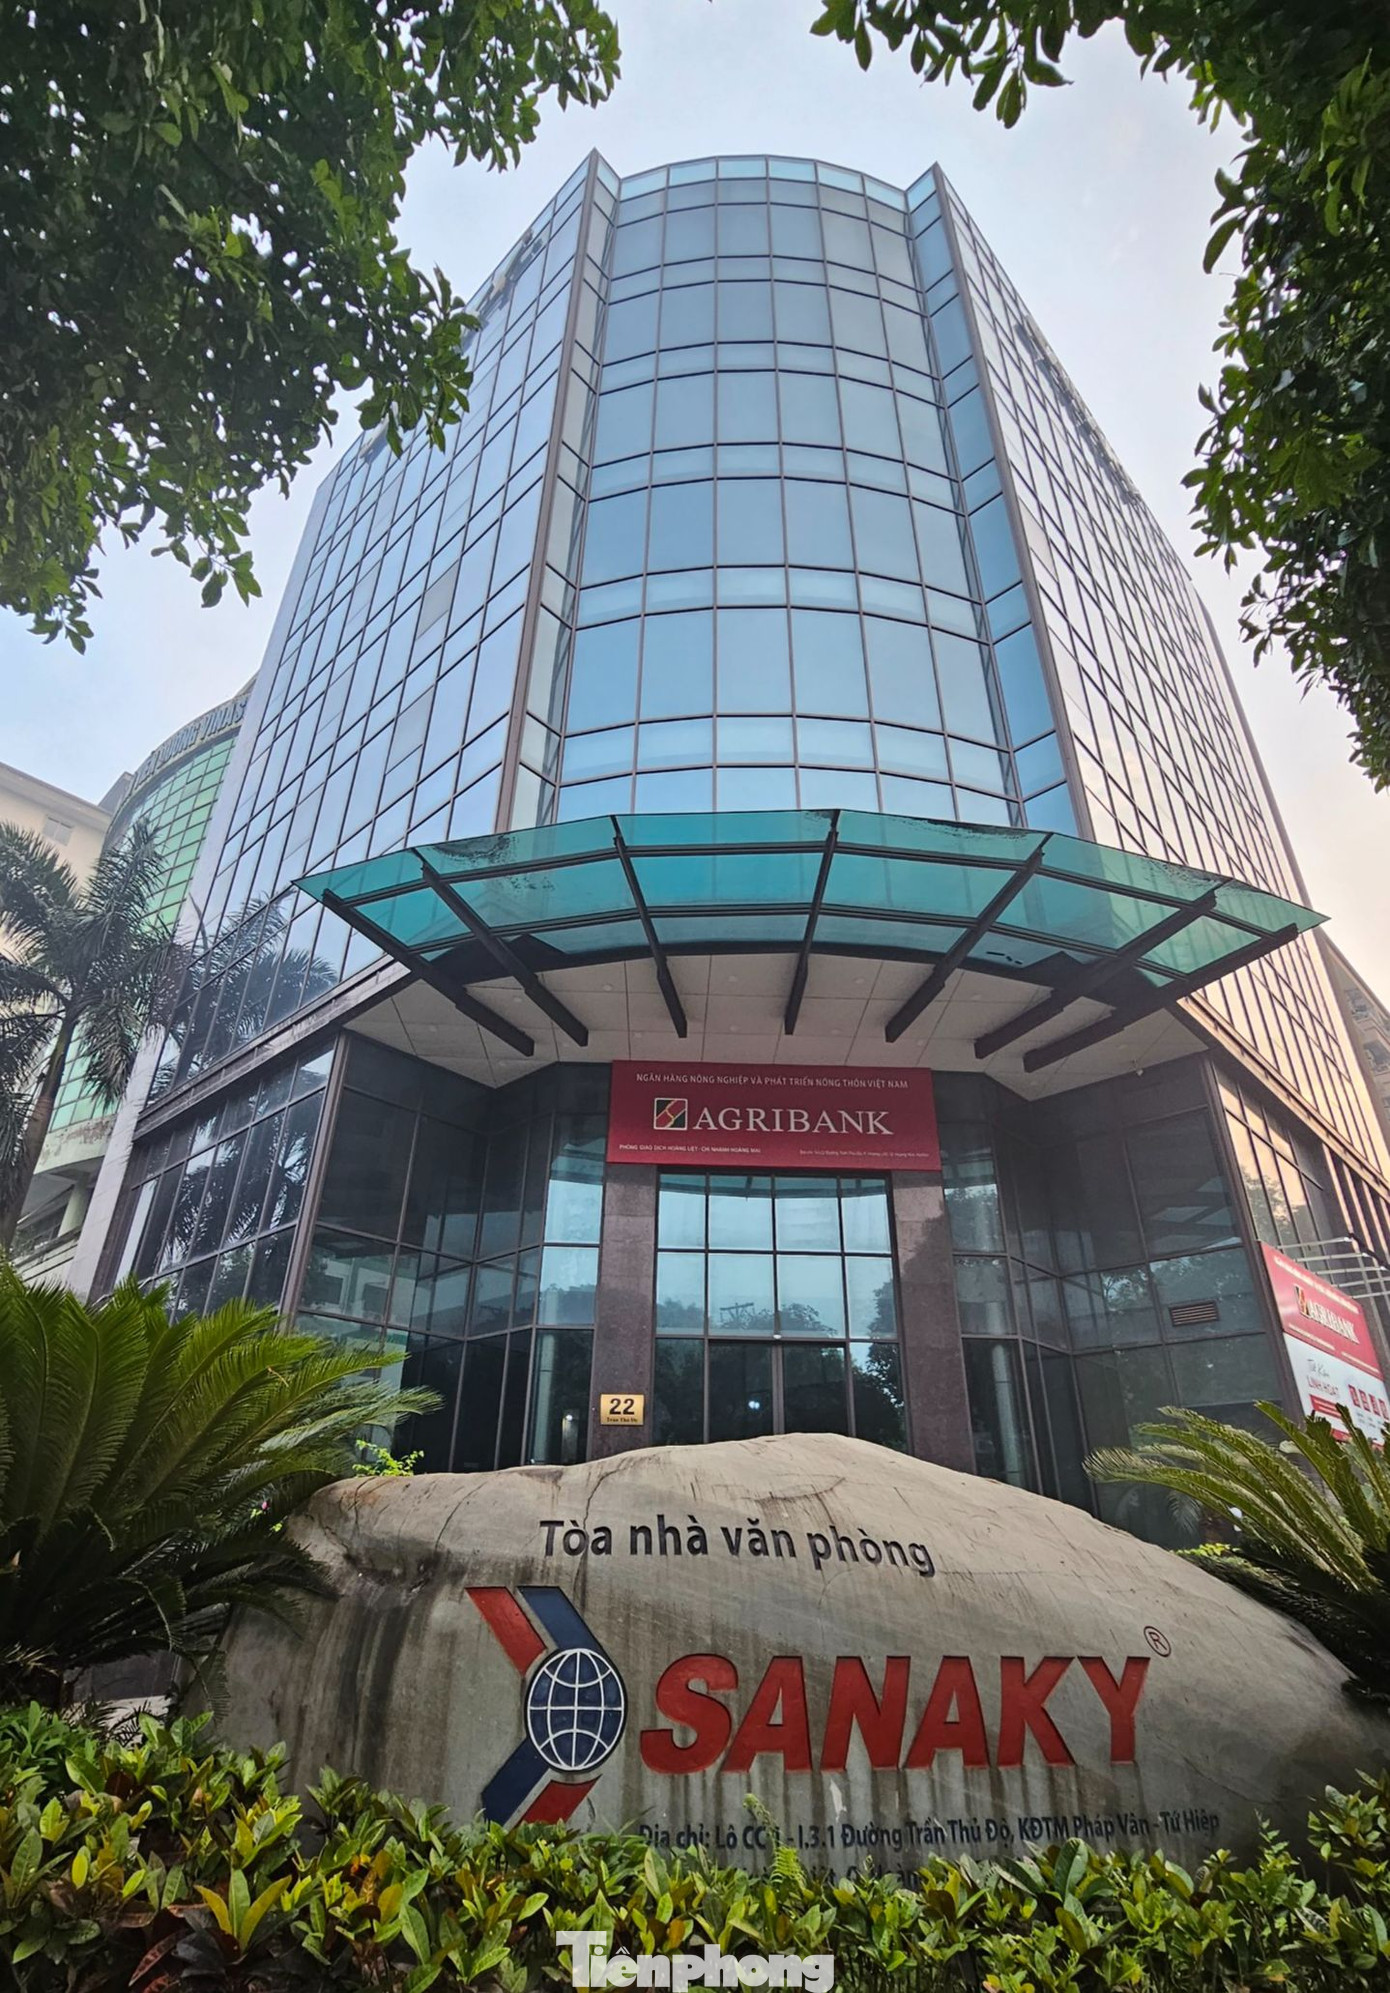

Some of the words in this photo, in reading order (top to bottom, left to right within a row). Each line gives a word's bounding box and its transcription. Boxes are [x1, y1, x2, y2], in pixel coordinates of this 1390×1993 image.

[636, 1073, 661, 1082] NGÂN
[663, 1073, 688, 1083] HÀNG
[690, 1074, 715, 1084] NÔNG
[717, 1075, 748, 1085] NGHIỆP
[750, 1075, 763, 1085] VÀ
[764, 1076, 787, 1085] PHÁT
[789, 1076, 814, 1087] TRIỂN
[816, 1077, 841, 1087] NÔNG
[843, 1078, 867, 1088] THÔN
[867, 1078, 886, 1089] VIỆT
[888, 1080, 909, 1089] NAM
[693, 1106, 894, 1135] AGRIBANK
[609, 1398, 635, 1415] 22
[540, 1519, 612, 1556] Tòa
[629, 1514, 708, 1556] nhà
[721, 1518, 796, 1557] văn
[807, 1526, 936, 1577] phòng
[640, 1653, 1151, 1774] SANAKY
[716, 1824, 737, 1849] Lô
[841, 1821, 902, 1852] Đường
[906, 1817, 946, 1846] Trần
[947, 1818, 981, 1844] Thủ
[985, 1818, 1014, 1848] Độ,
[1018, 1816, 1069, 1841] KĐTM
[1073, 1814, 1115, 1842] Pháp
[1117, 1812, 1150, 1836] Vân
[1183, 1808, 1219, 1837] Hiệp
